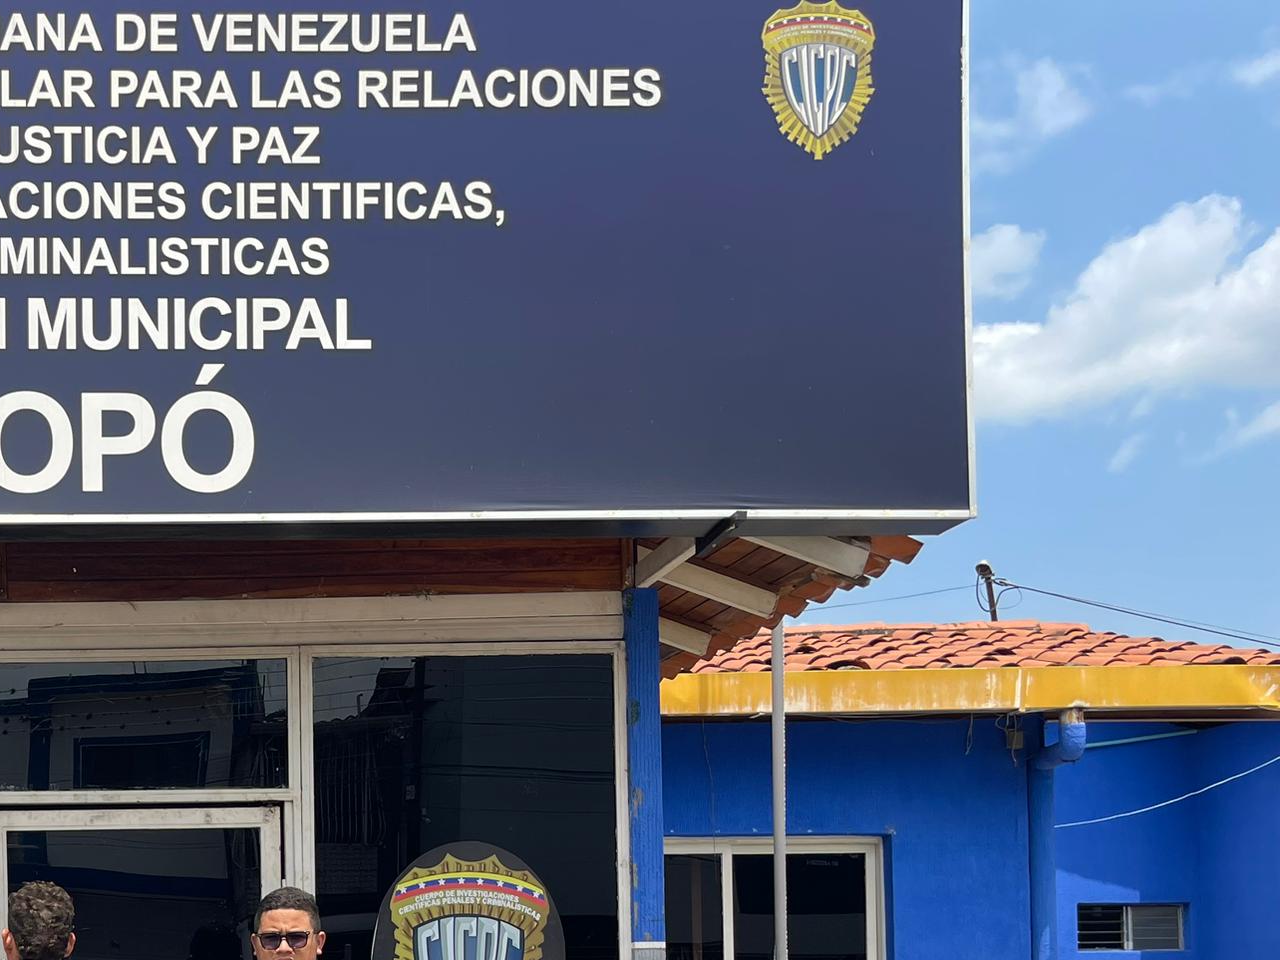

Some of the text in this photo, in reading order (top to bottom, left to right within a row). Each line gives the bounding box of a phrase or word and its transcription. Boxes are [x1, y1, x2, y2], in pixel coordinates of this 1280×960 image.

[117, 13, 178, 51] DE
[192, 14, 477, 53] VENEZUELA
[111, 70, 238, 109] PARA
[252, 69, 342, 108] LAS
[358, 69, 662, 108] RELACIONES
[781, 43, 856, 137] CICPC
[186, 126, 219, 164] Y
[233, 126, 321, 164] PAZ
[201, 181, 505, 227] CIENTIFICAS,
[27, 297, 372, 351] MUNICIPAL
[414, 891, 445, 903] CUERPO
[446, 890, 456, 898] DE
[442, 896, 475, 906] PENALES
